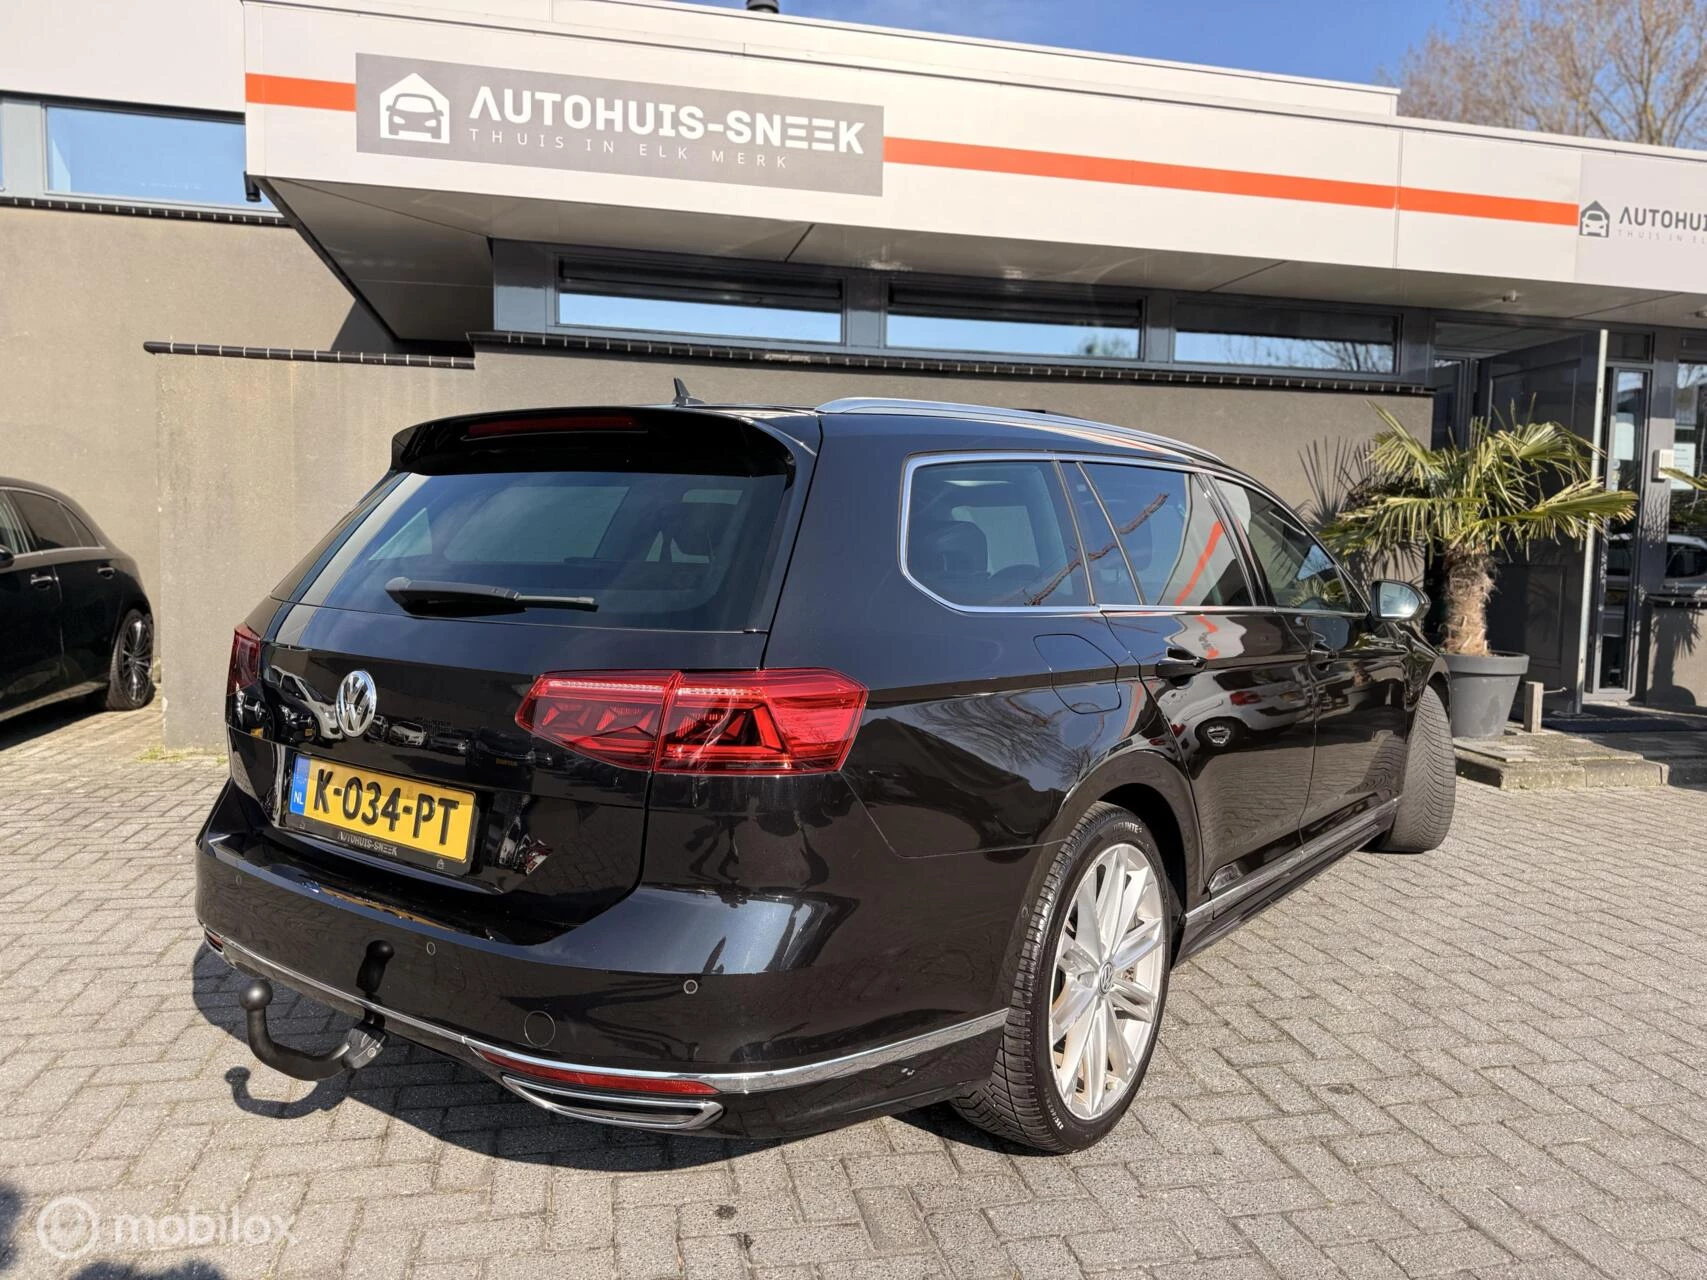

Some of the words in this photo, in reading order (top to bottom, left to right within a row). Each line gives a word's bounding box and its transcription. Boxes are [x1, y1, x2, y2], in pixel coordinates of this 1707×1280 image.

[468, 86, 866, 155] AUTOHUIS-SNEEK
[469, 128, 564, 149] THUIS
[586, 139, 614, 153] IN
[639, 143, 688, 160] ELK
[711, 150, 787, 169] MERK
[293, 791, 304, 806] NL
[313, 768, 460, 846] K-034-PT
